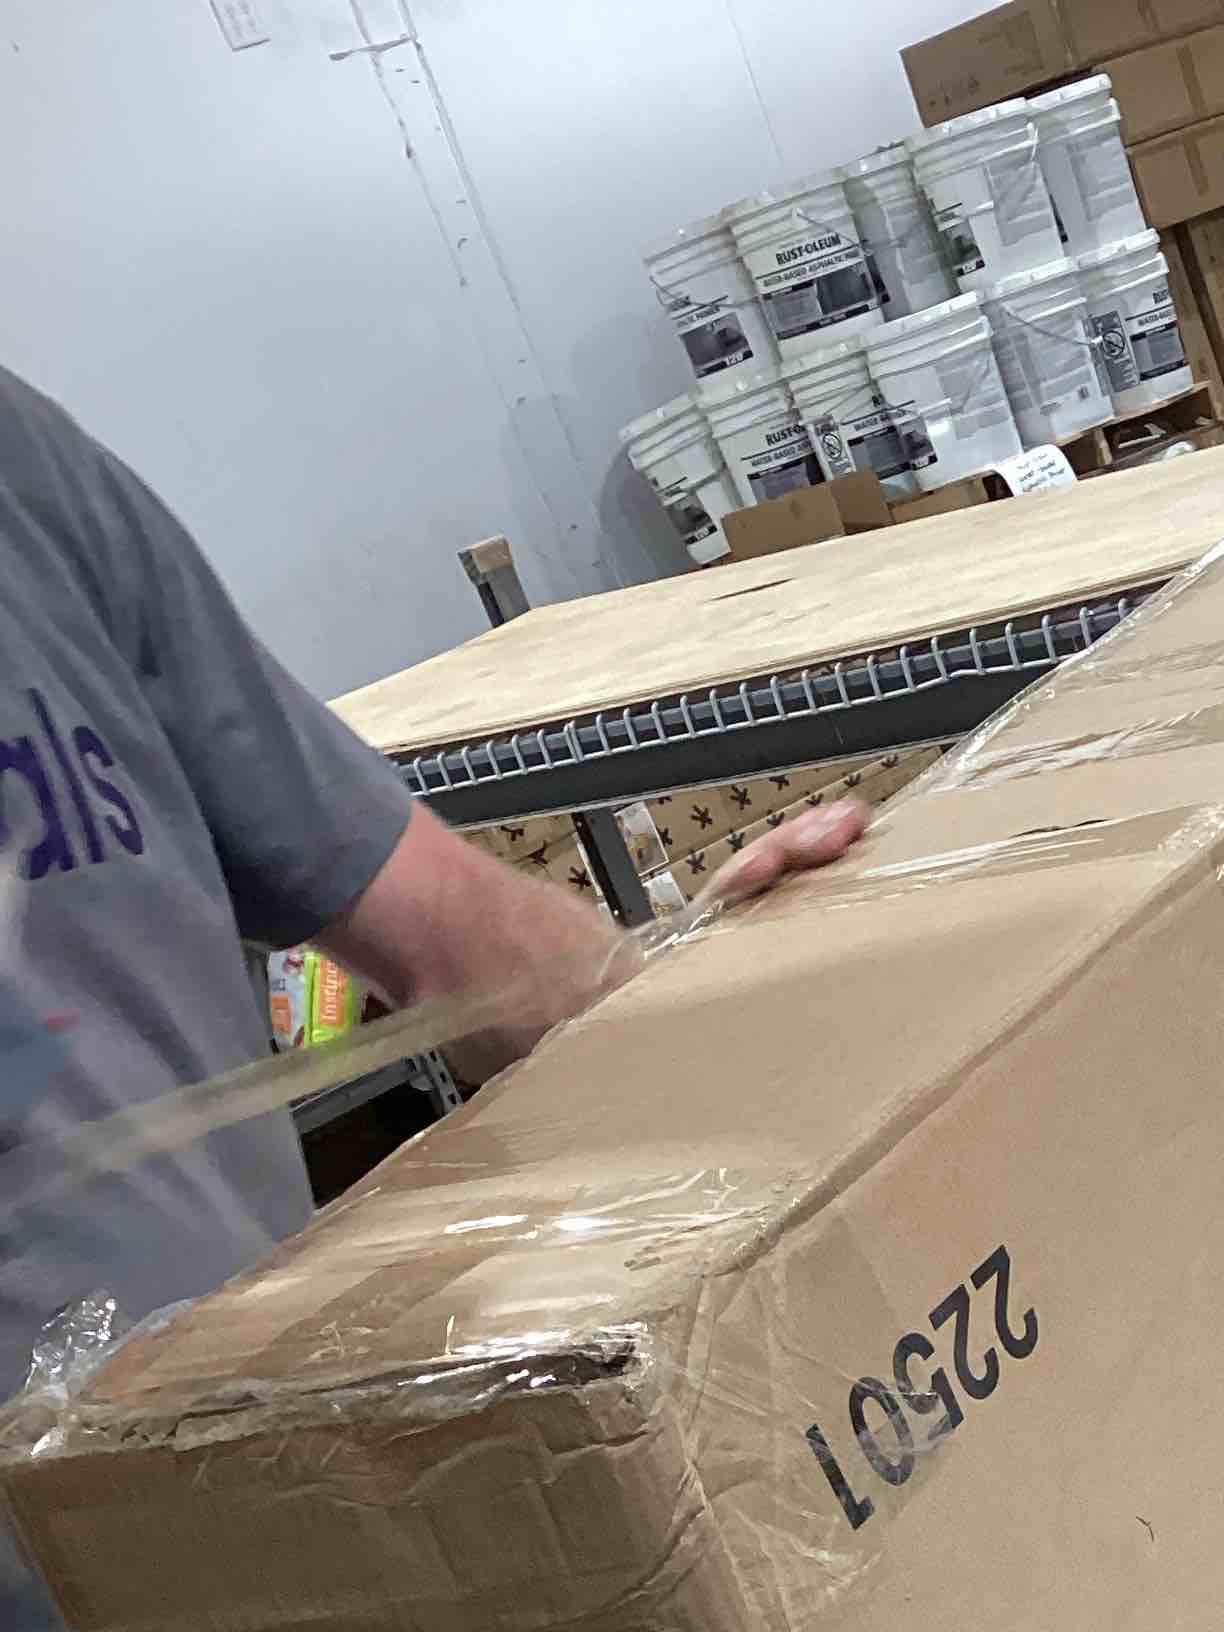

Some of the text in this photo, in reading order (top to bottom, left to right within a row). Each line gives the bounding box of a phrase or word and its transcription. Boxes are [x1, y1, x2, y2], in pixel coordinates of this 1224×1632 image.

[775, 231, 841, 265] RUST-OLEUM
[765, 423, 807, 447] RUST-O
[805, 1243, 1039, 1531] 22501
